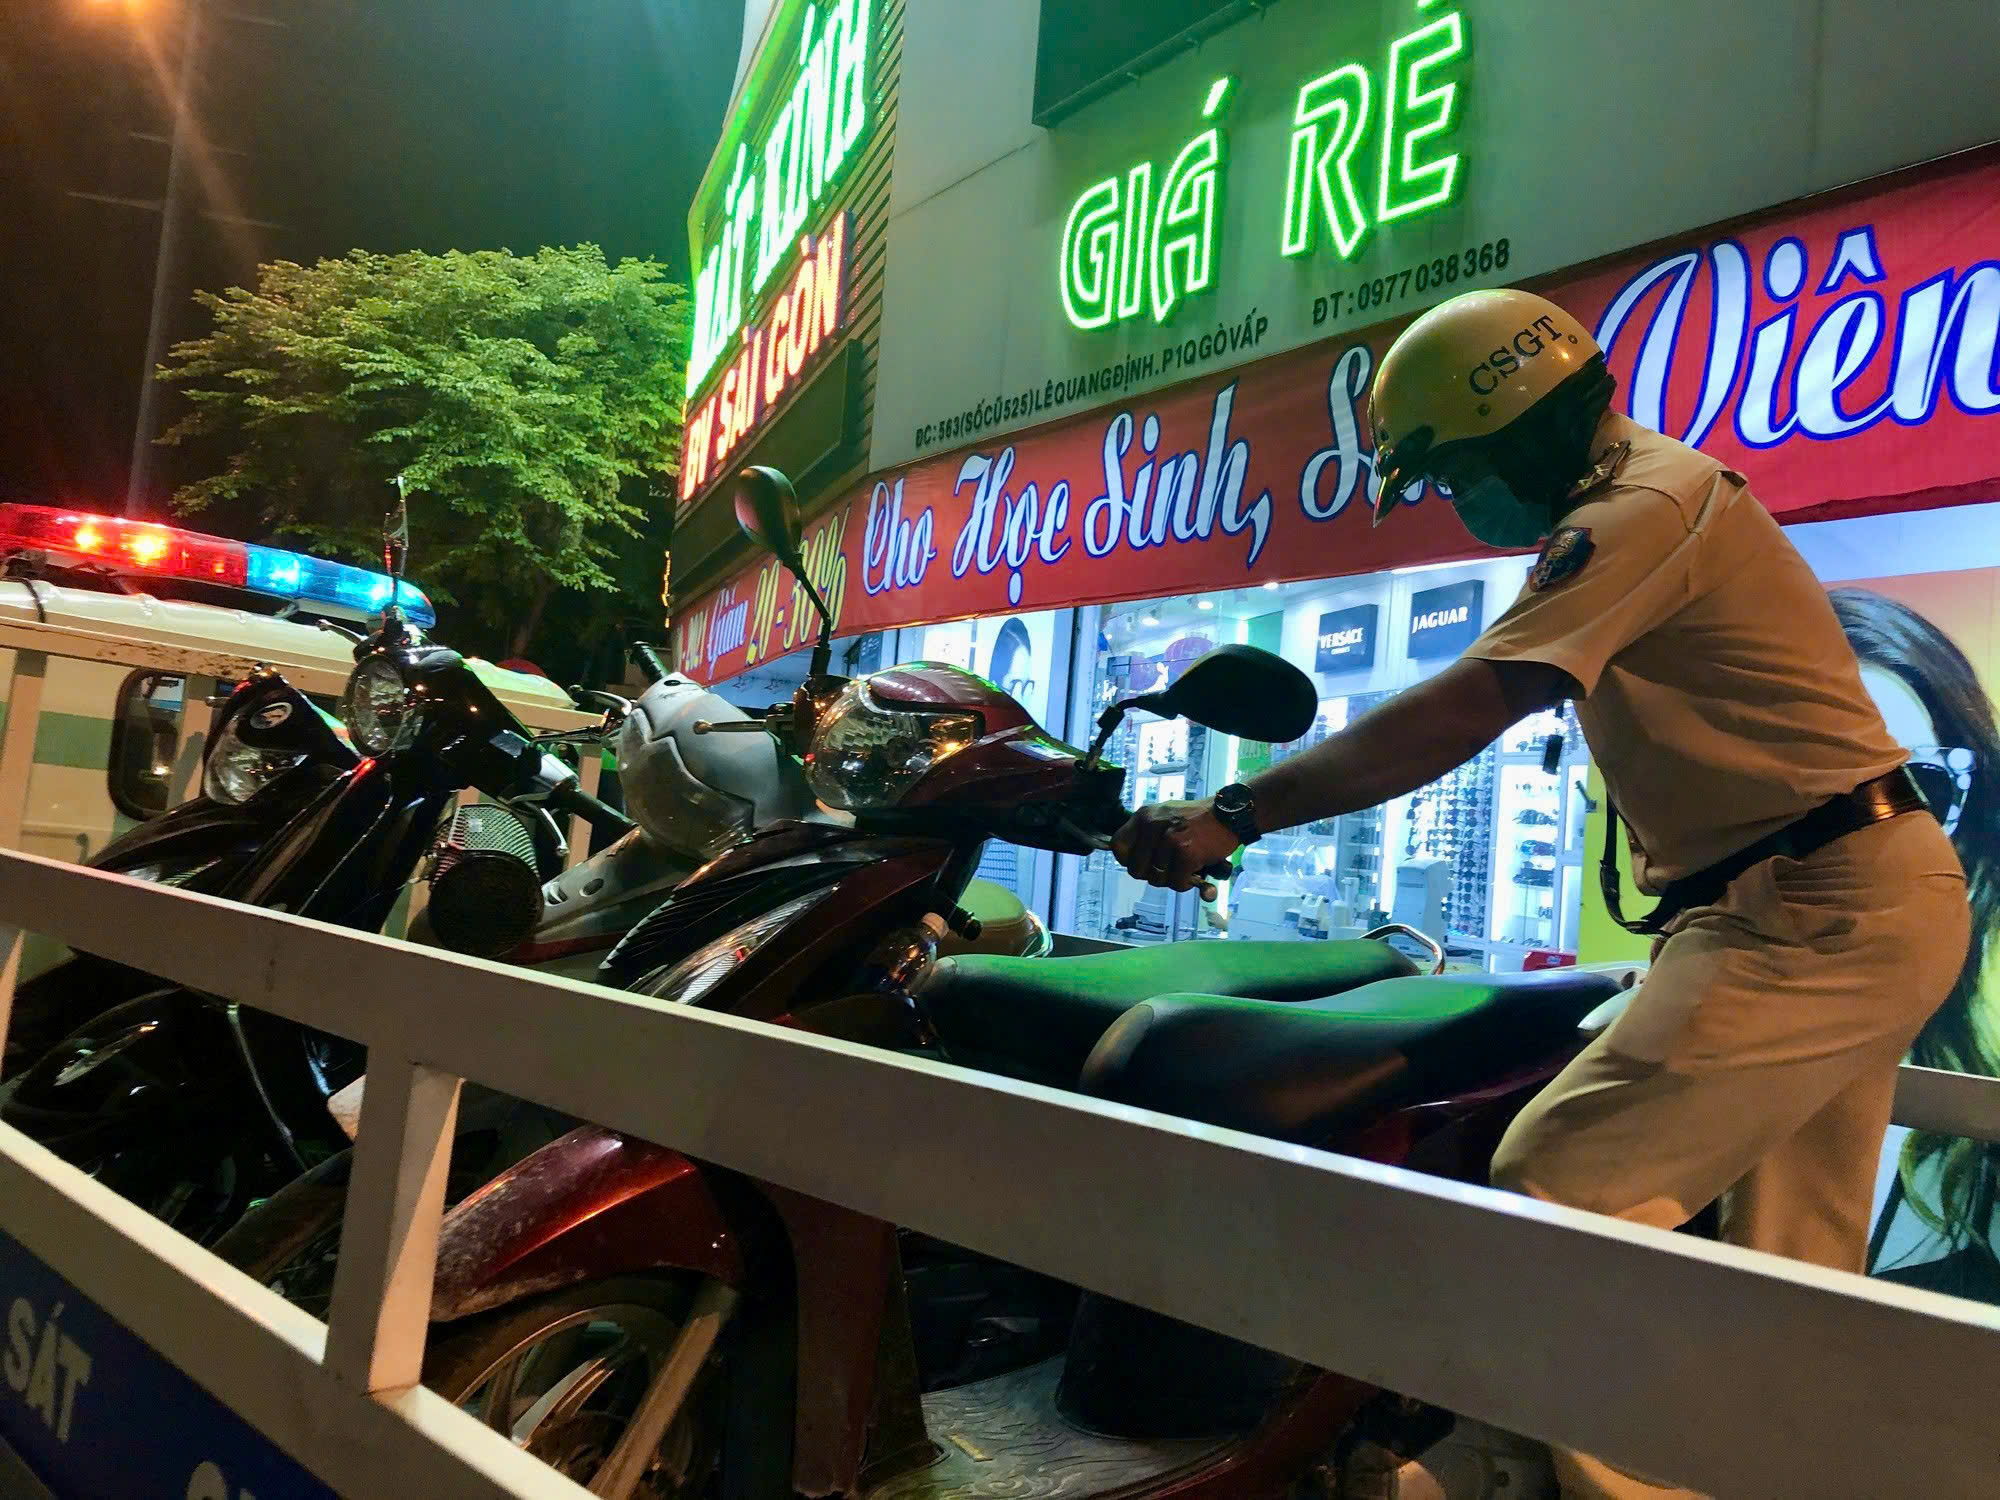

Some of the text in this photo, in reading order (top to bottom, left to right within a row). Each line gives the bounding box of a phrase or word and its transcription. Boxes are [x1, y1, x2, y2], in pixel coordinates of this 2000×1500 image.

[1060, 77, 1230, 330] GIÁ
[1469, 315, 1563, 396] CSGT
[683, 396, 716, 500] BV
[863, 478, 937, 595] Cho
[952, 446, 1072, 605] Học
[1083, 382, 1273, 572] Sinh,
[1593, 224, 2000, 449] Viên
[1319, 627, 1364, 649] VERSACE
[1411, 606, 1469, 634] JAGUAR
[3, 1298, 93, 1442] SÁT
